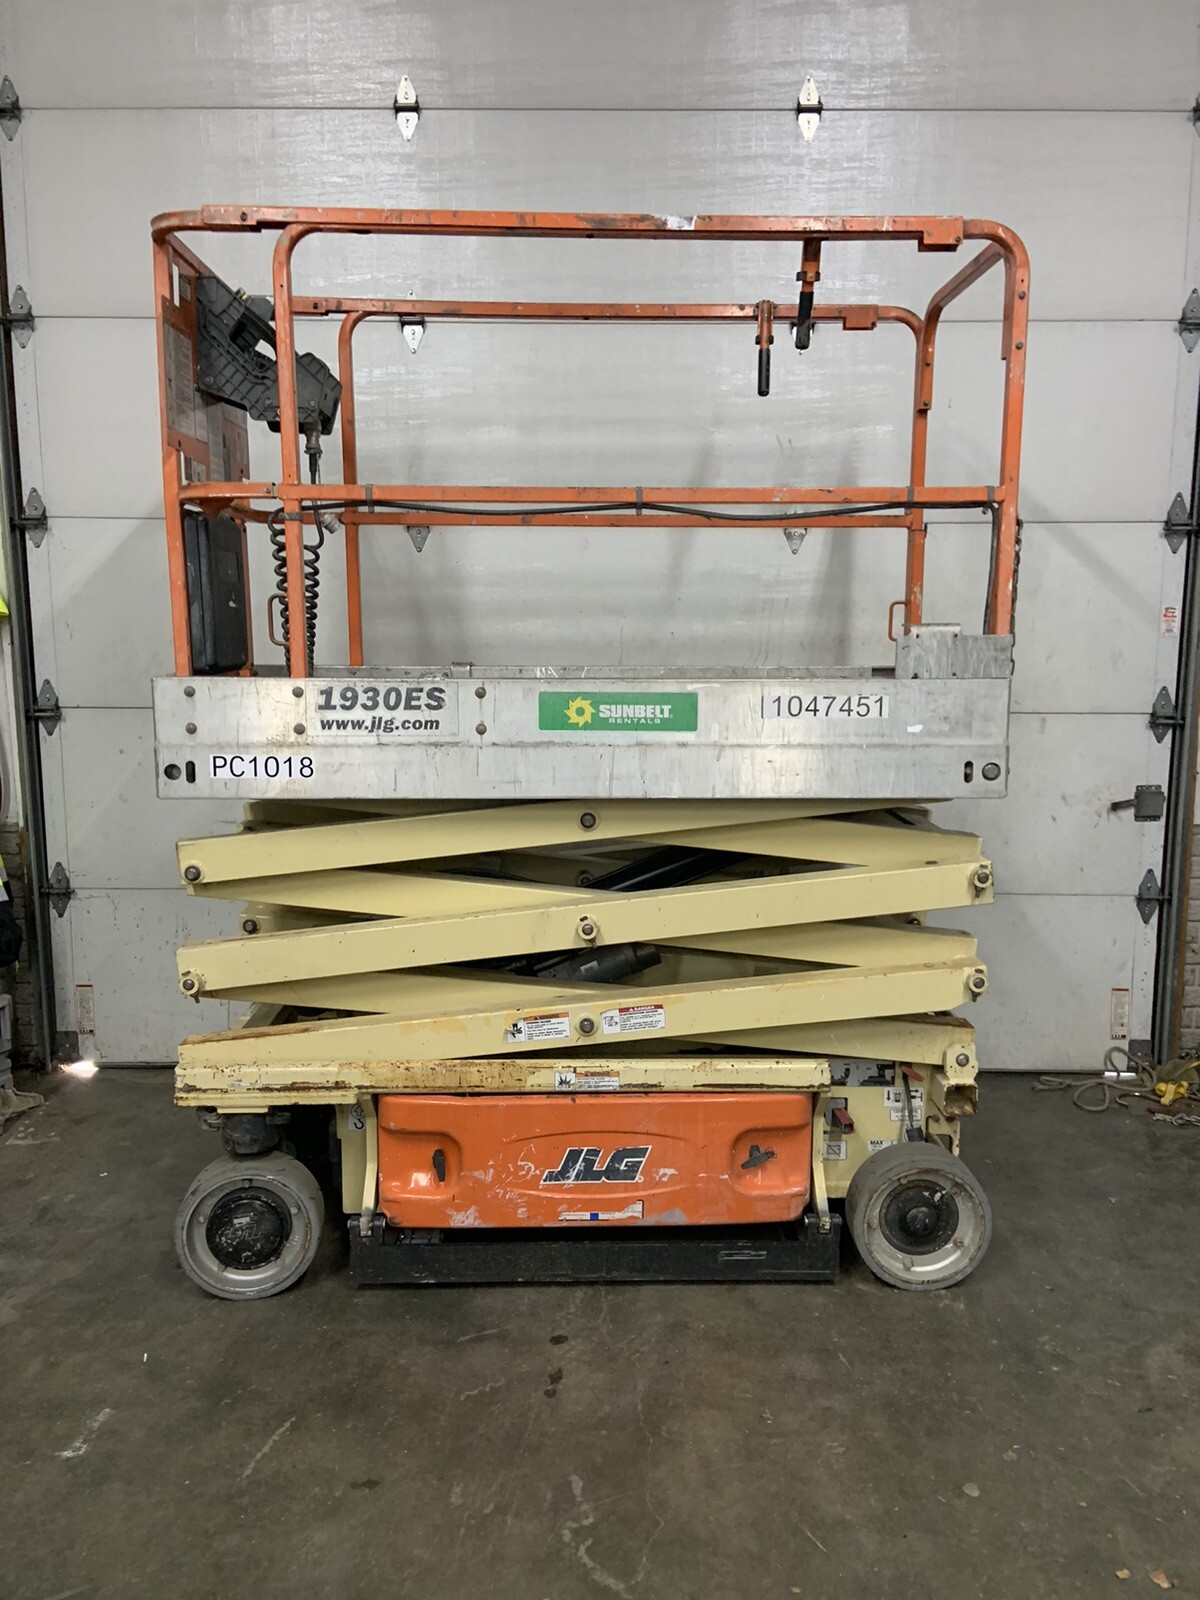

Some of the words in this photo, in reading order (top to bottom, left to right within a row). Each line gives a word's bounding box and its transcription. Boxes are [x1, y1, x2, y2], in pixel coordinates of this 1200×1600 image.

[317, 686, 447, 711] 1930ES
[773, 695, 886, 718] 1047451
[598, 704, 672, 719] SUNBELT
[319, 716, 440, 734] www.jlg.com
[211, 755, 315, 779] PC1018
[538, 1144, 652, 1184] JLG
